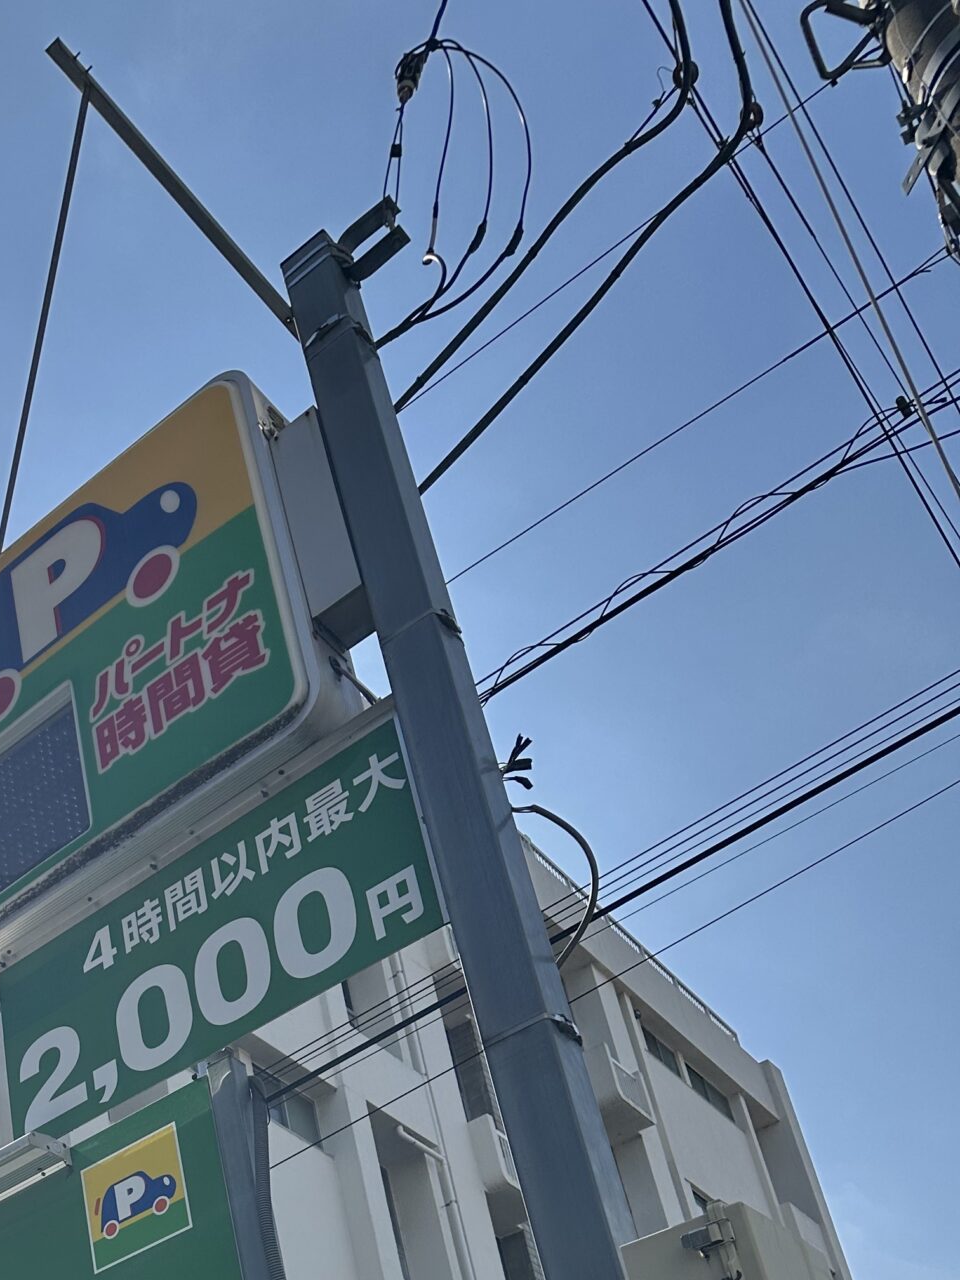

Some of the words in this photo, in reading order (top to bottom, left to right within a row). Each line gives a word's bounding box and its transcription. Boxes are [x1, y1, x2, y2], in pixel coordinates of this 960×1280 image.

[10, 516, 106, 664] P
[90, 568, 255, 724] パートナ
[92, 609, 270, 775] 時間貸
[83, 751, 407, 974] 4時間以内最大
[19, 864, 425, 1137] 2,000円
[114, 1175, 146, 1222] P
